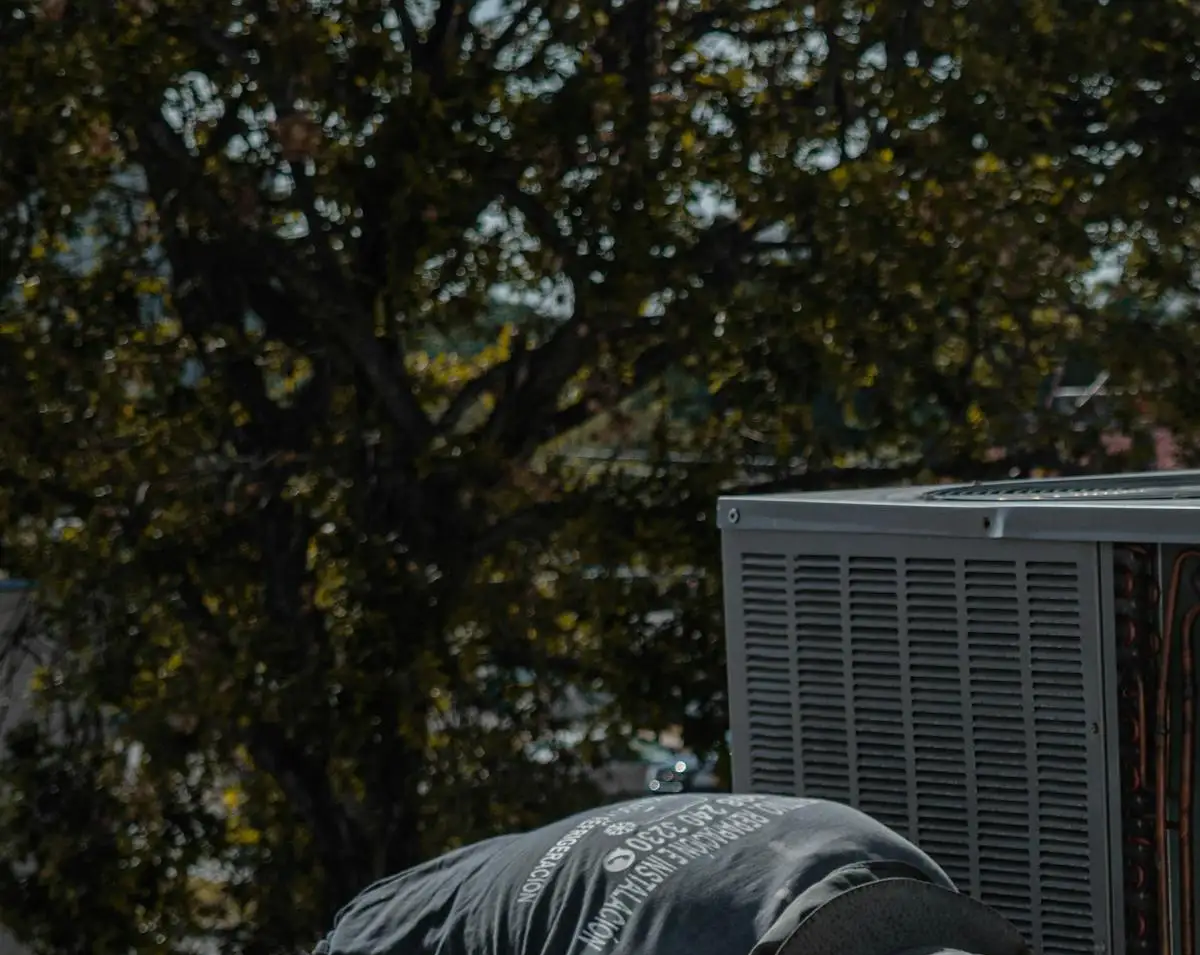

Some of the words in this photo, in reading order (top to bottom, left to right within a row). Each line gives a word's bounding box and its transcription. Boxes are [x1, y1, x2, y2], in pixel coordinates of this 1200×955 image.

[677, 804, 728, 827] 240
[625, 821, 690, 852] 3230
[657, 847, 690, 867] E
[576, 853, 679, 952] INSTALACIÓN
